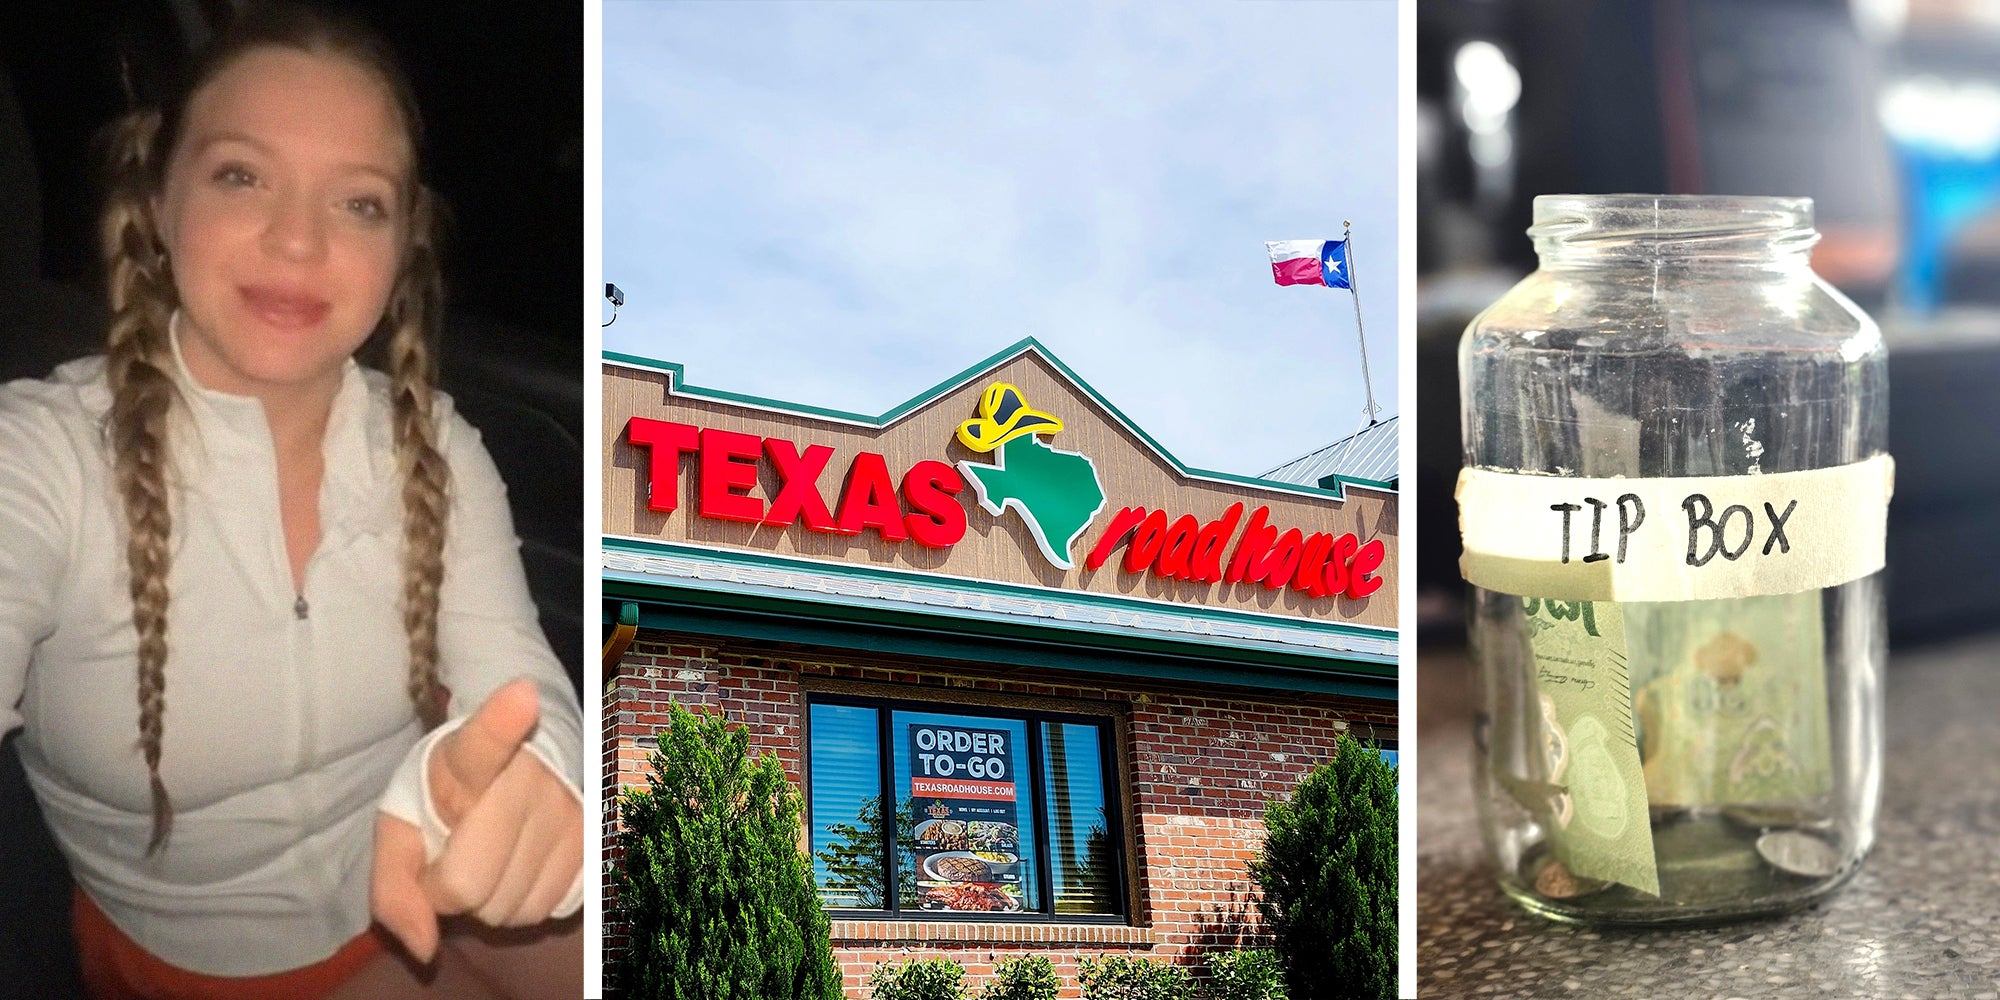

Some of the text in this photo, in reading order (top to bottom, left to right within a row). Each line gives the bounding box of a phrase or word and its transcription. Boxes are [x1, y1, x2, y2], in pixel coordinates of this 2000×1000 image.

[628, 416, 967, 548] TEXAS
[1550, 493, 1798, 567] TIP BOX
[916, 728, 1005, 754] ORDER
[918, 753, 1005, 779] TO-GO
[914, 782, 1013, 796] TEXASROADHOUSE.COM
